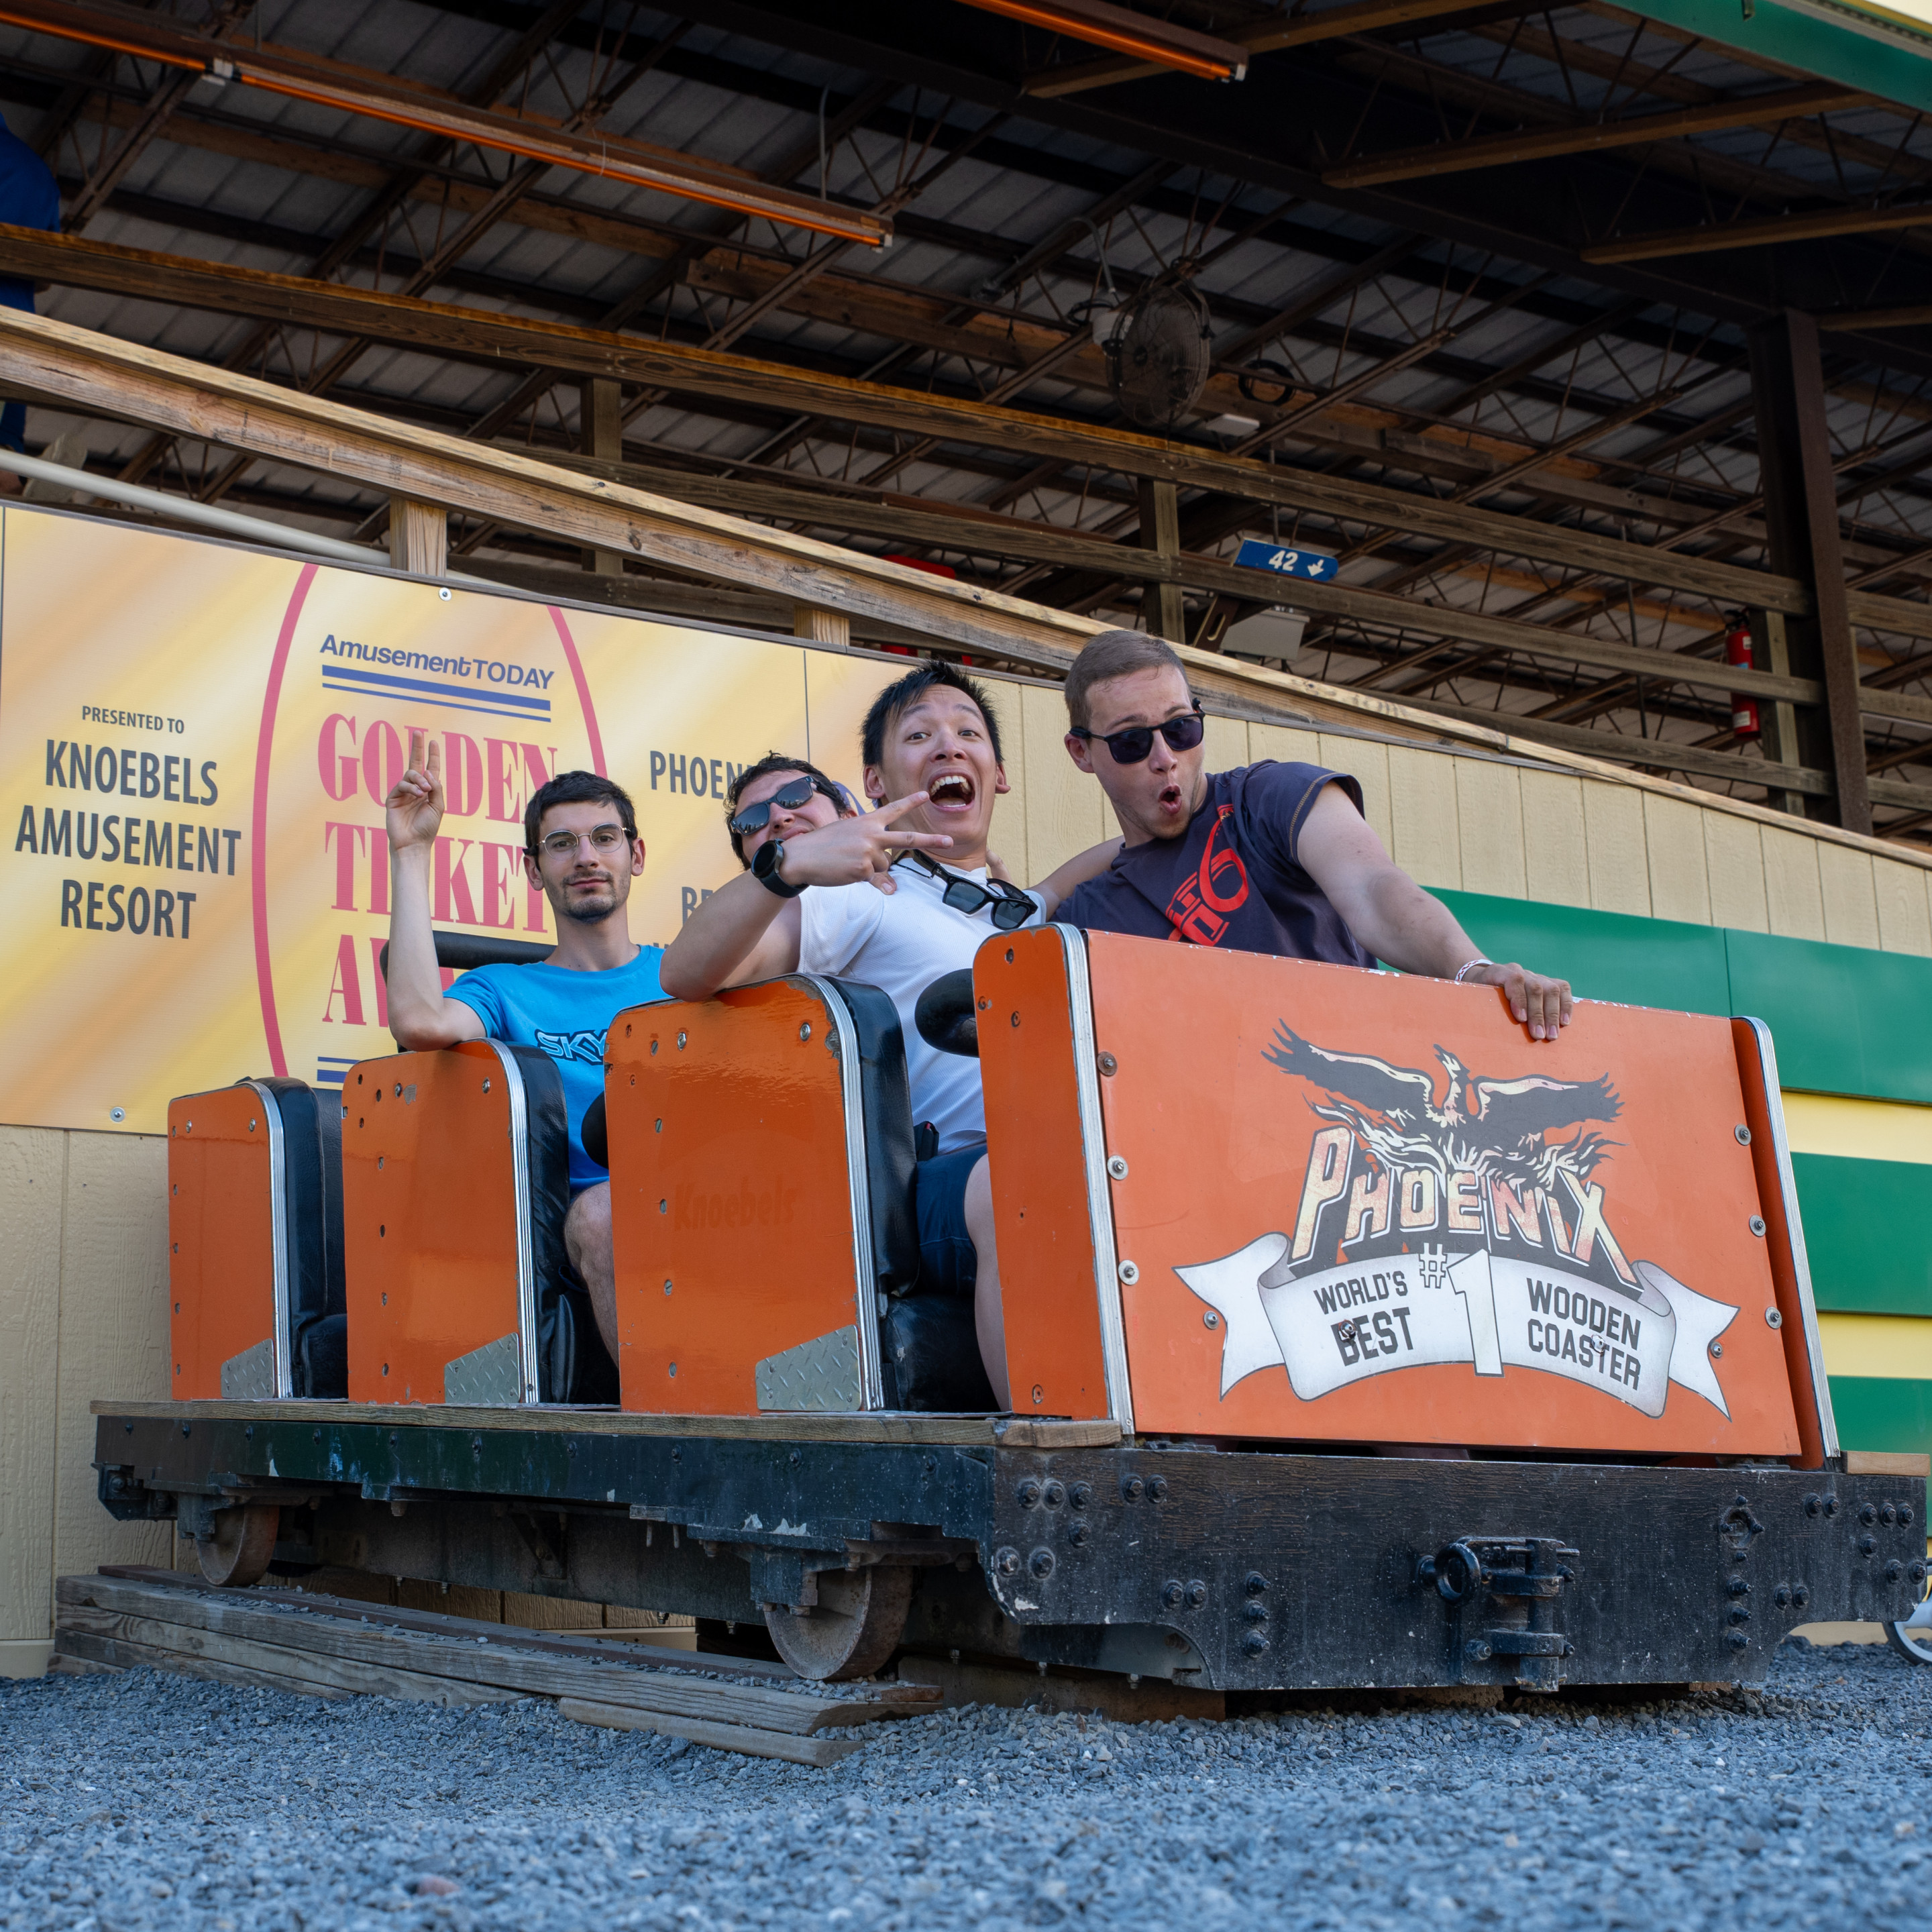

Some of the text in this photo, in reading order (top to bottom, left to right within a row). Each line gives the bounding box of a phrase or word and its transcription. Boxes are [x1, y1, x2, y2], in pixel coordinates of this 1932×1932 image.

[1268, 549, 1298, 572] 42
[82, 705, 184, 734] PRESENTED TO
[45, 739, 219, 807] KNOEBELS
[14, 804, 242, 877] AMUSEMENT
[60, 879, 197, 940] RESORT
[325, 821, 548, 934] TIKET
[1313, 1269, 1409, 1316] WORLD'S
[1526, 1277, 1642, 1351] WOODEN
[1330, 1306, 1414, 1367] BEST
[1527, 1318, 1642, 1391] COASTER
